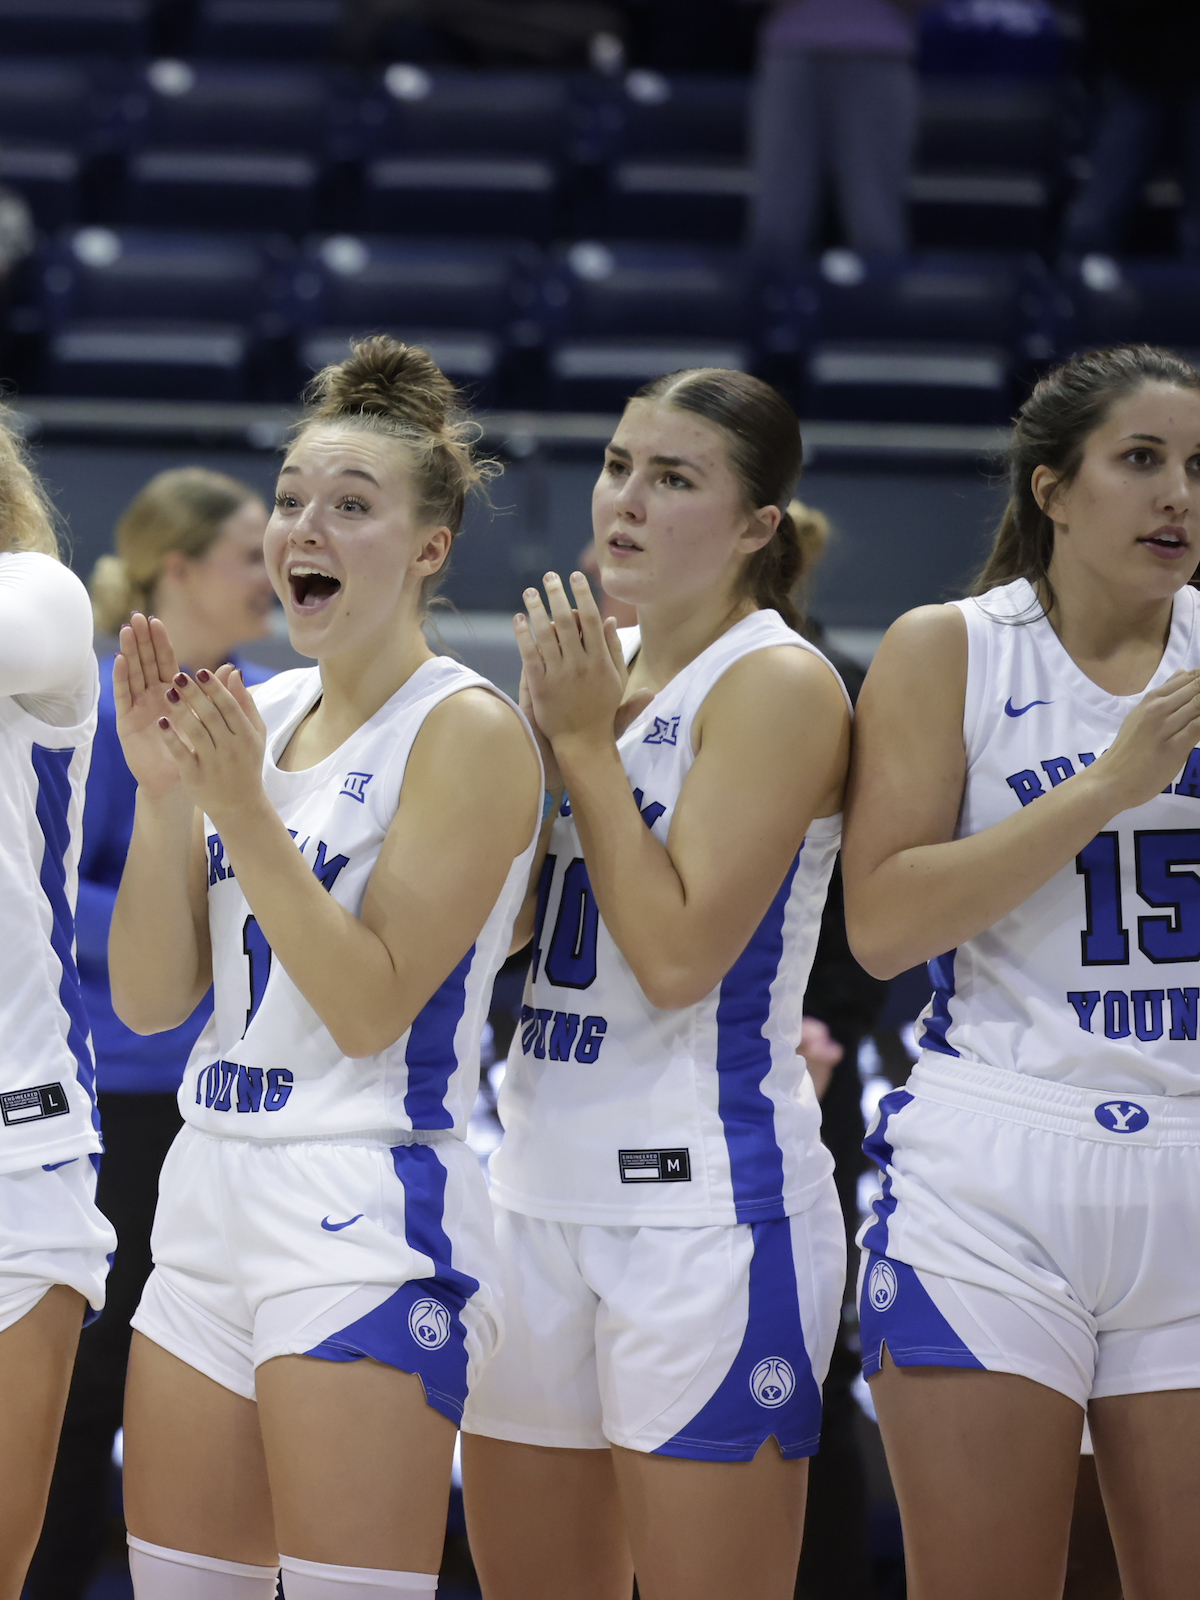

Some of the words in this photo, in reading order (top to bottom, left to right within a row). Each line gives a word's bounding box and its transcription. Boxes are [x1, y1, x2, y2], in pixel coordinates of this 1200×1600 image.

[1076, 828, 1200, 966] 15
[521, 1004, 608, 1064] OUNG
[1067, 987, 1200, 1042] YOUN
[48, 1094, 59, 1107] L
[1103, 1103, 1141, 1131] Y
[667, 1158, 680, 1172] M
